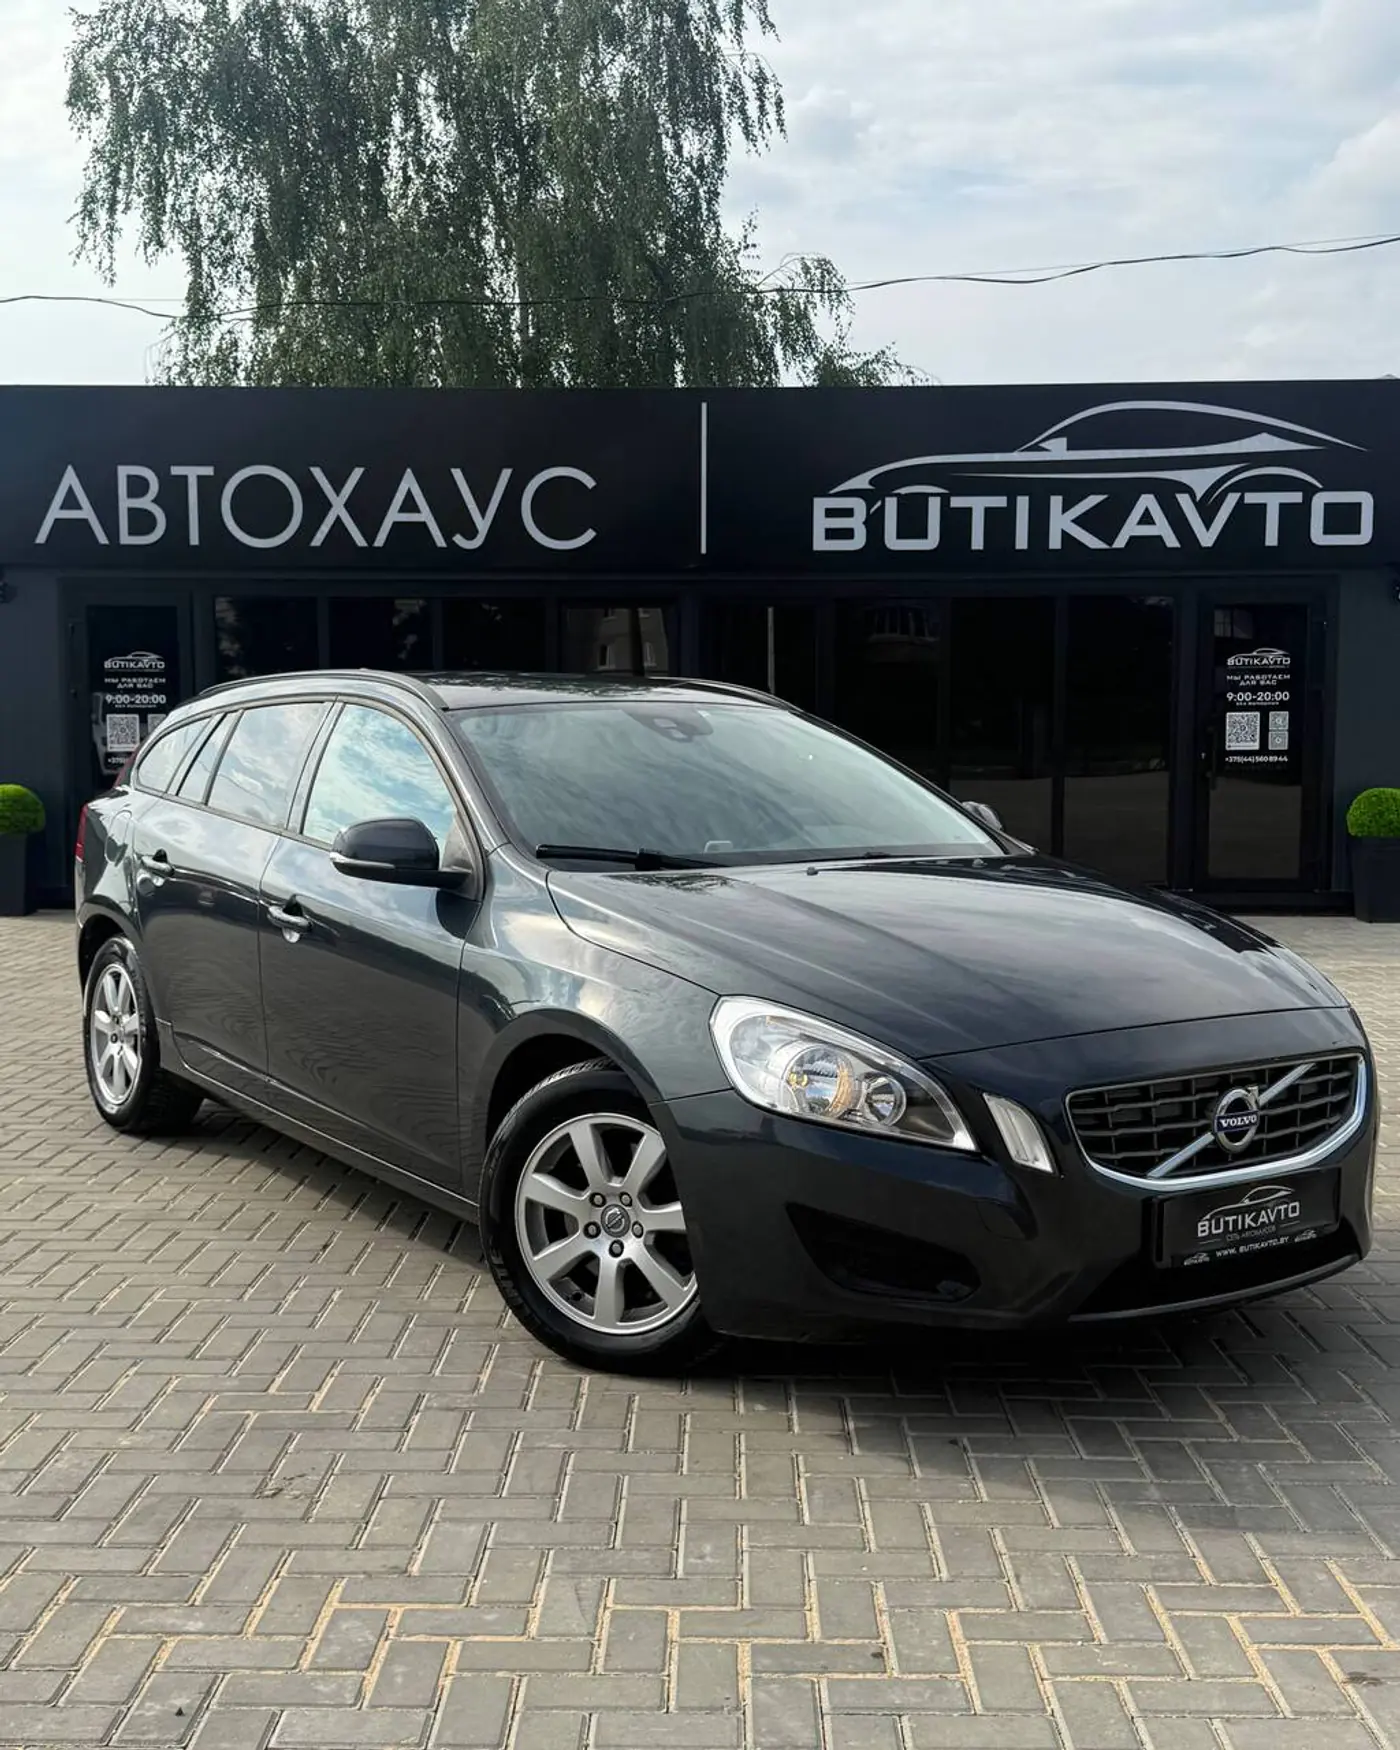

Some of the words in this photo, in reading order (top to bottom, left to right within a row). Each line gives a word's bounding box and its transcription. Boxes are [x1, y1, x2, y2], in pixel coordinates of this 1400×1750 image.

[35, 464, 598, 550] АВТОХАУС
[812, 491, 1374, 551] BUTIKAVTO
[103, 660, 166, 669] BUTIKAVTO
[1227, 657, 1291, 666] BUTIKAVTO
[105, 694, 166, 704] 9:00-20:00
[1226, 691, 1290, 702] 9:00-20:00
[1219, 1114, 1258, 1128] VOLVO
[1197, 1201, 1300, 1237] BUTIKAVTO
